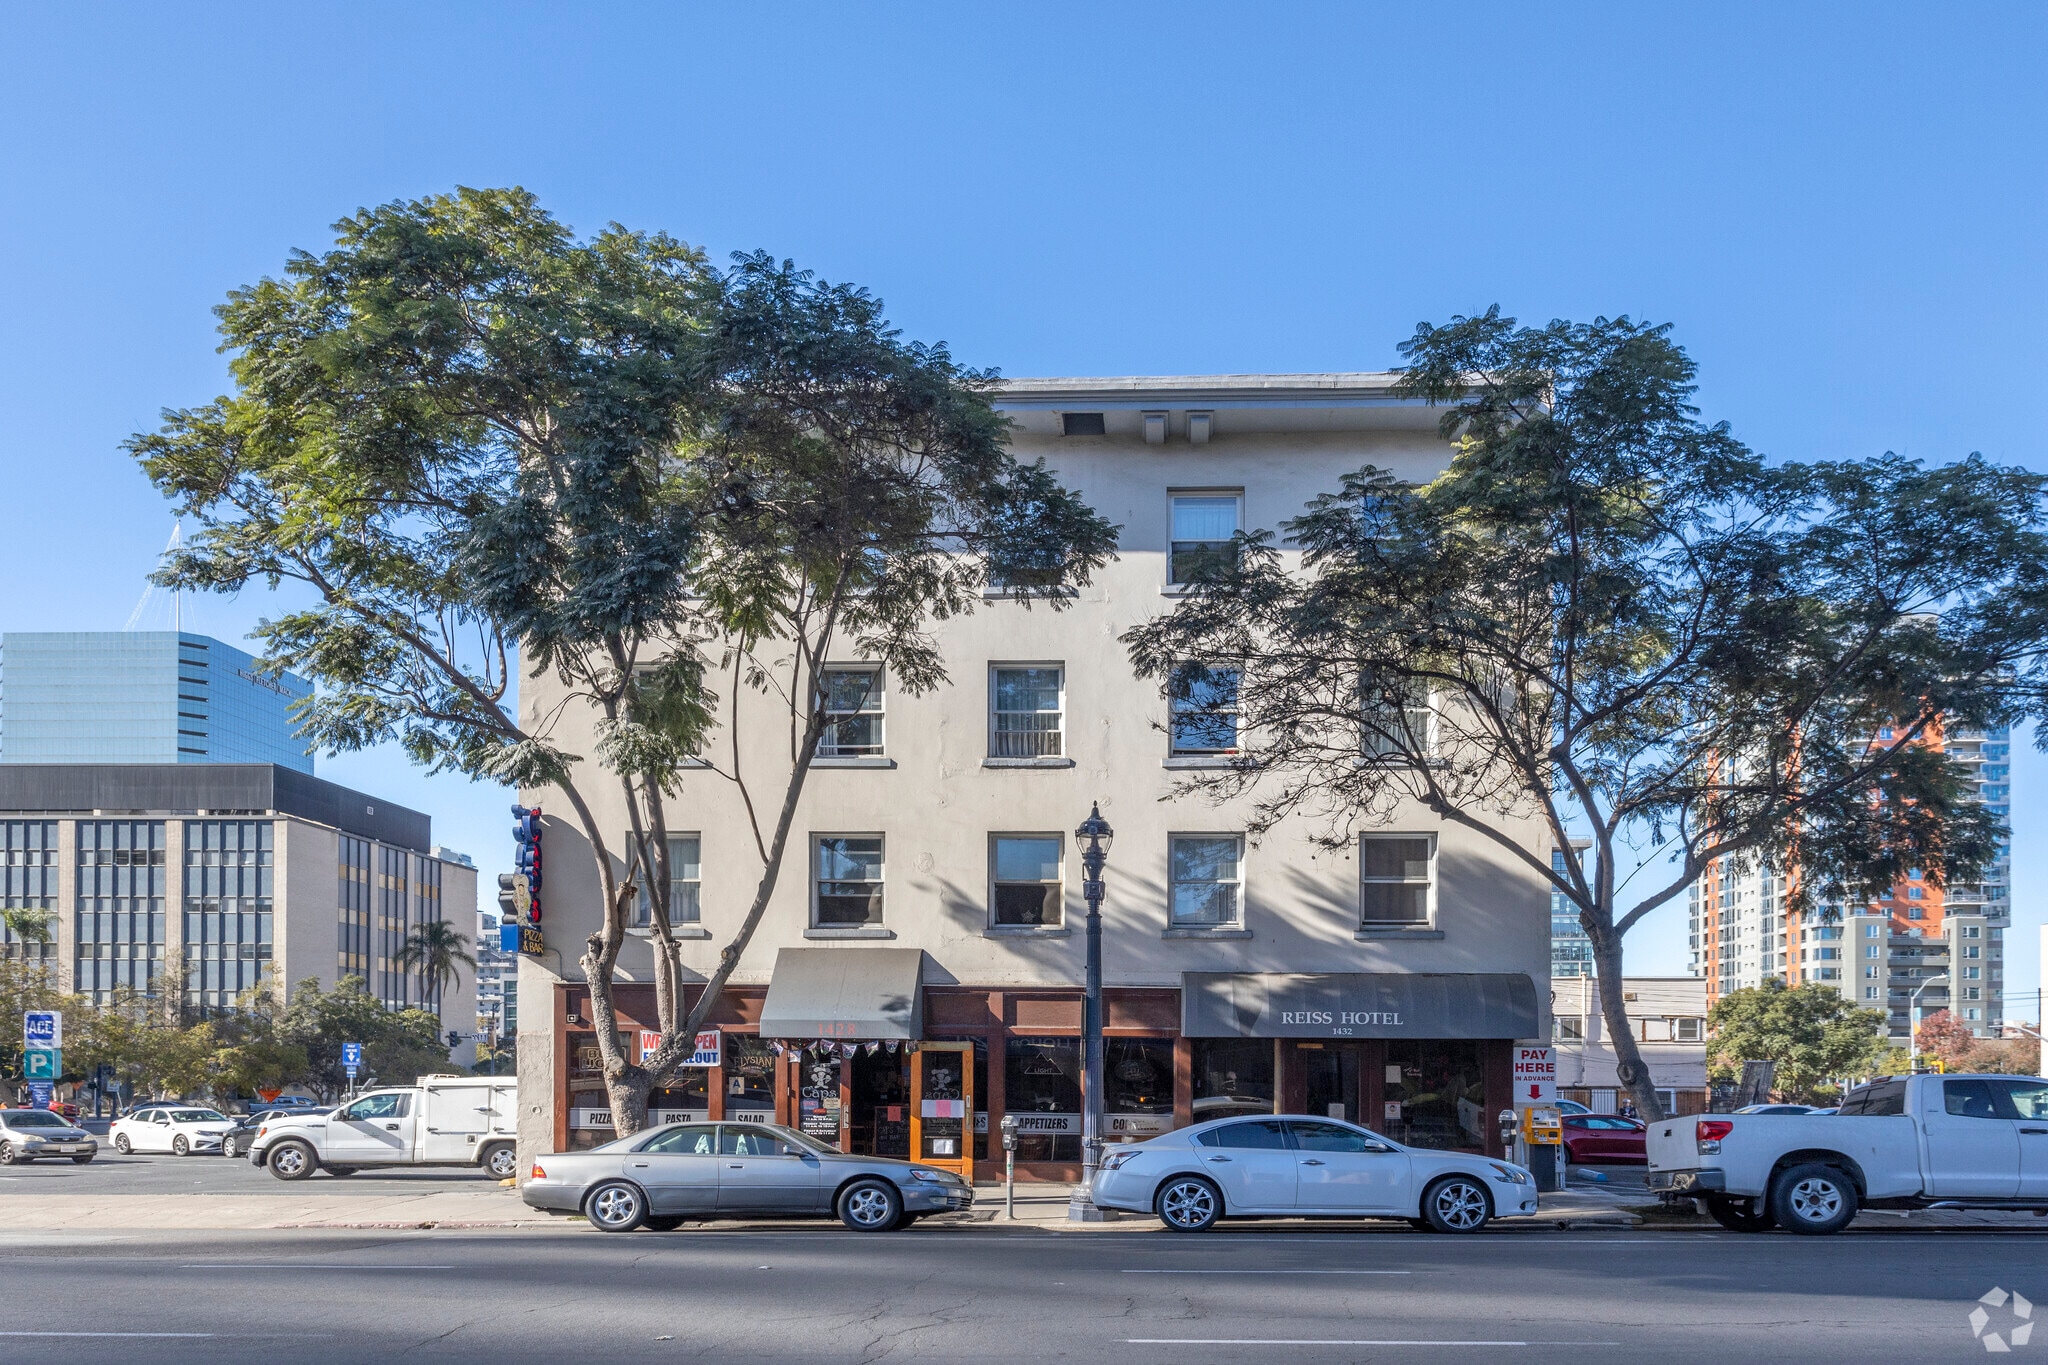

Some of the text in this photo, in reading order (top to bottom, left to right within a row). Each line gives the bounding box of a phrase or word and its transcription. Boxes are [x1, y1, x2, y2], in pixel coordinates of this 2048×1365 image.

[523, 928, 544, 942] PIZZA
[529, 942, 544, 954] BAR
[1281, 1011, 1404, 1025] REISS HOTEL
[28, 1020, 53, 1035] ACE
[817, 1022, 857, 1037] 1428
[1332, 1027, 1353, 1036] 1432
[695, 1033, 718, 1050] PEN
[1521, 1049, 1548, 1060] PAY
[30, 1053, 48, 1075] P
[734, 1055, 773, 1068] ELYSIAN
[1515, 1063, 1555, 1073] HERE
[733, 1079, 741, 1088] A
[802, 1086, 837, 1100] Caps
[589, 1113, 612, 1124] PIZZA
[665, 1113, 692, 1123] PASTA
[738, 1114, 765, 1123] SALAD
[1018, 1117, 1069, 1130] APPETIZERS
